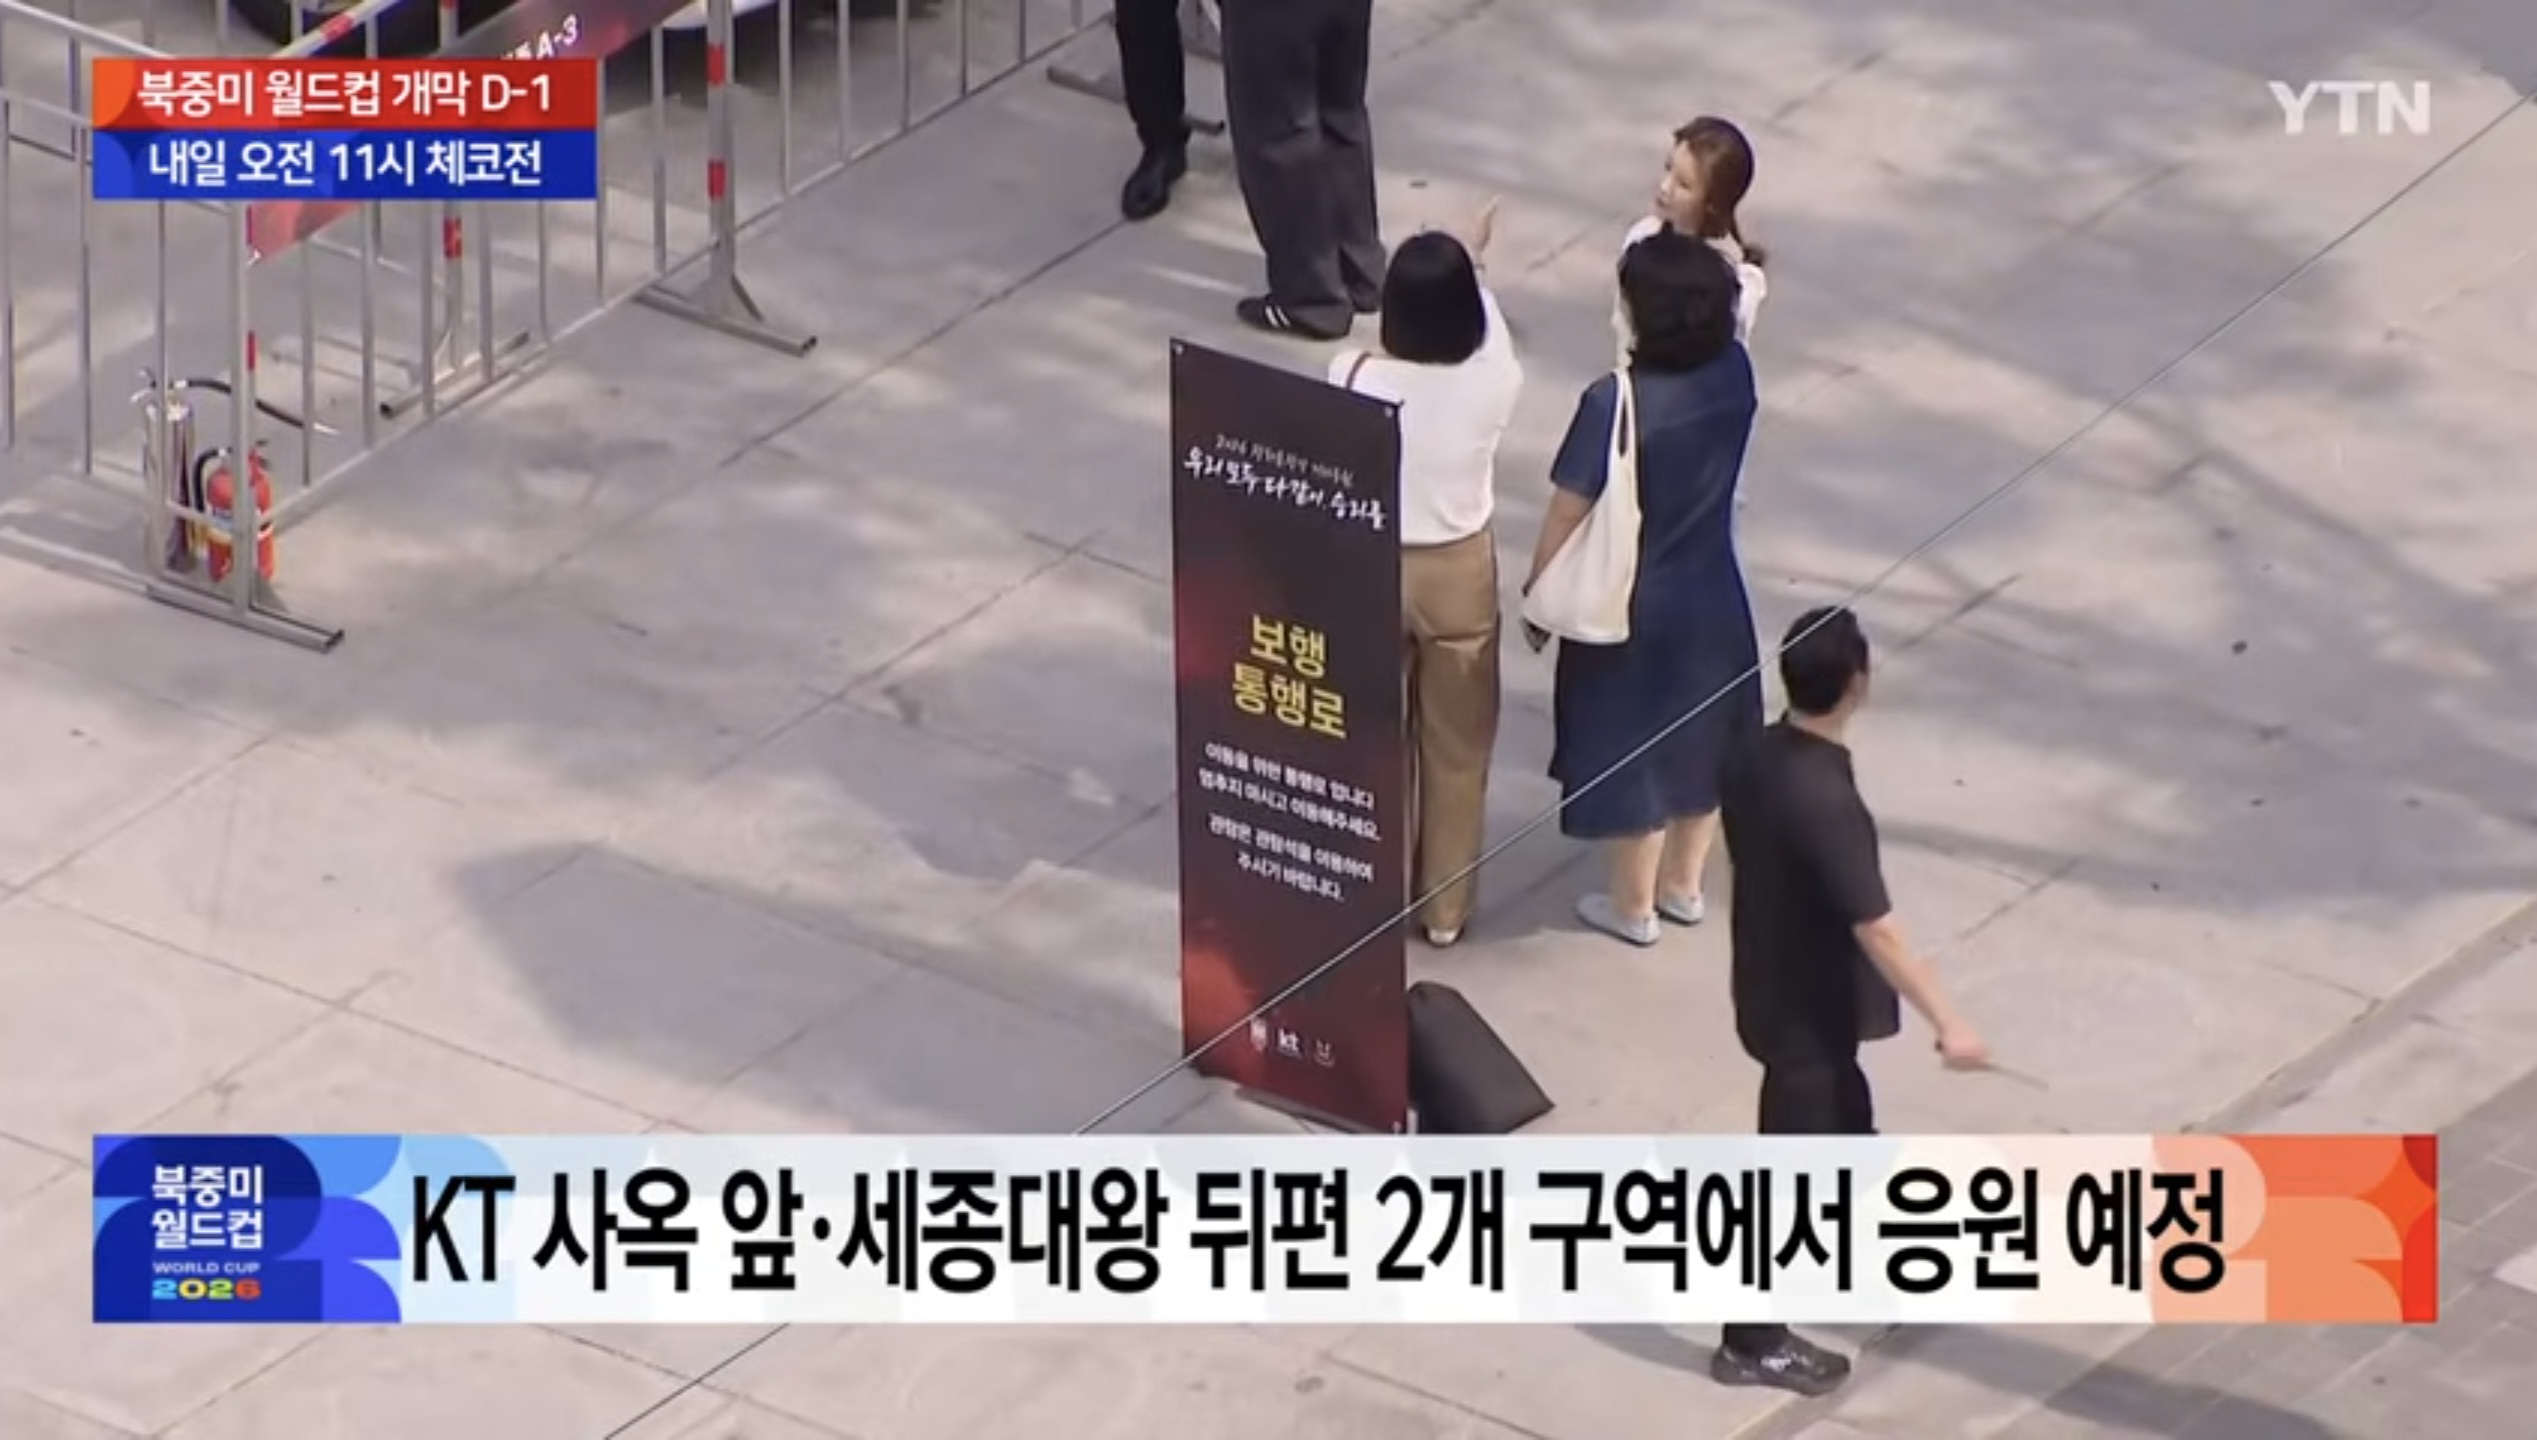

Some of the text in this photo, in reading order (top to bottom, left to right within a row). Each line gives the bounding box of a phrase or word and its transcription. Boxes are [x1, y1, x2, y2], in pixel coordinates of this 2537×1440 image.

[536, 13, 578, 60] A-3
[1250, 614, 1325, 678] 보행
[1233, 662, 1347, 739] 통행로
[1199, 767, 1242, 798] 멈추지
[1244, 782, 1287, 811] 마시고
[1205, 742, 1249, 772] 이동을
[1253, 755, 1282, 782] 위한
[1285, 765, 1327, 796] 통행로
[1209, 812, 1251, 844] 관람은
[1237, 850, 1281, 881] 주시기
[1279, 1028, 1299, 1051] kt
